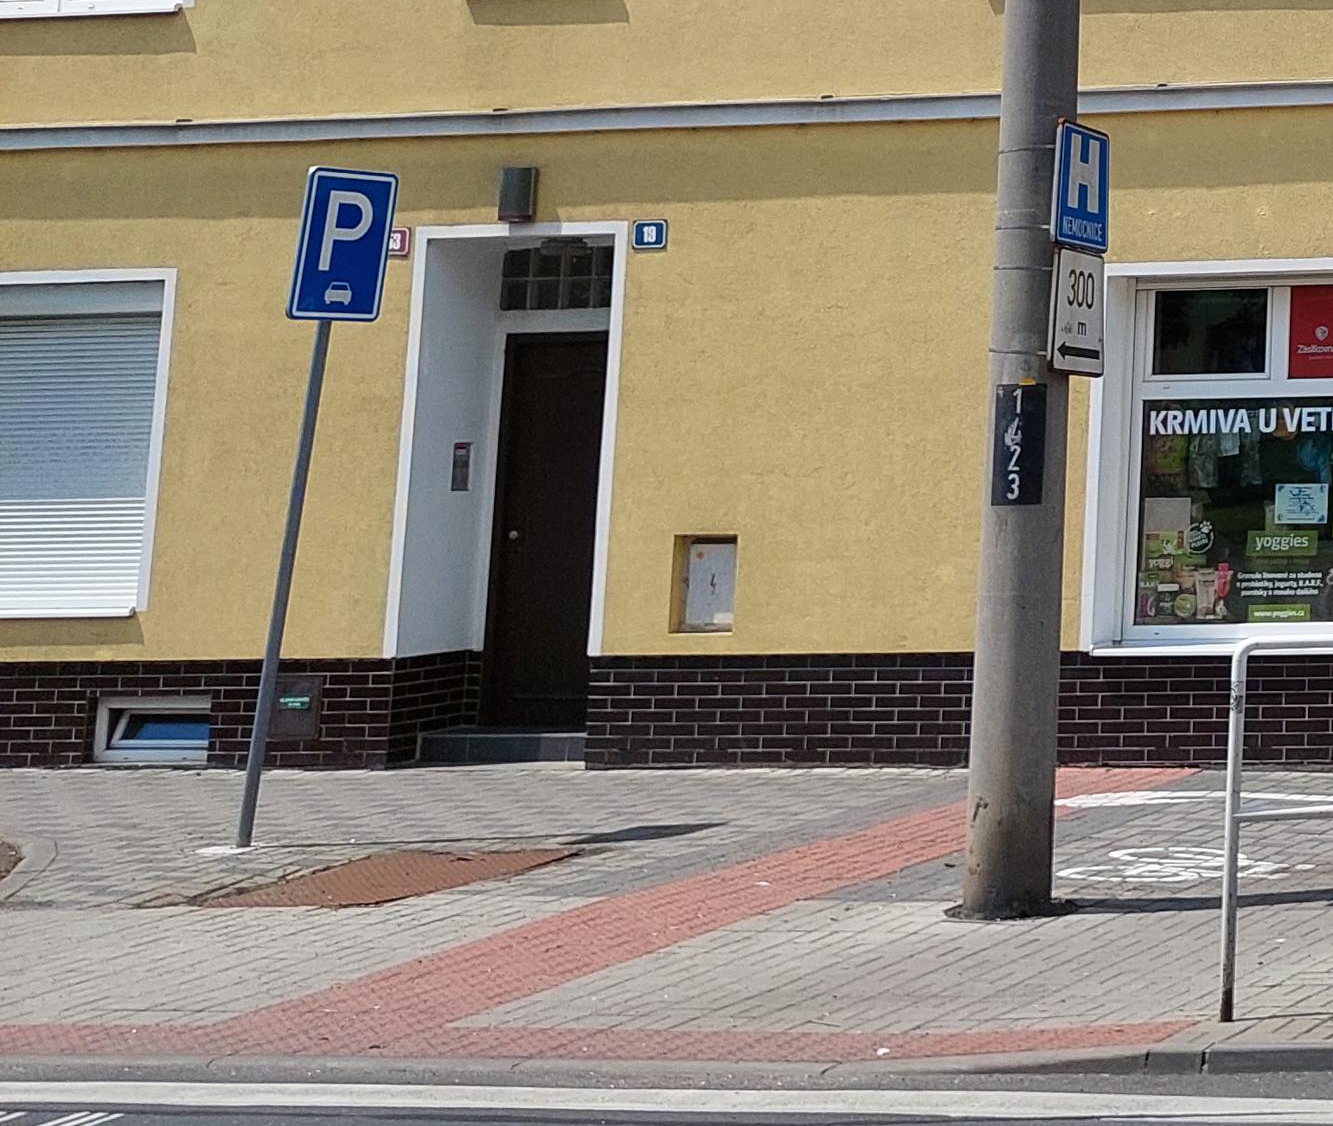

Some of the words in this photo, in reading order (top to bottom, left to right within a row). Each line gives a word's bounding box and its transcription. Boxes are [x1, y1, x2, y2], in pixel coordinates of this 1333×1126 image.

[1067, 133, 1100, 214] H
[318, 189, 374, 271] P
[643, 225, 657, 243] 19
[1062, 215, 1103, 242] NEMOCNICE
[1067, 268, 1095, 309] 300
[1077, 321, 1087, 336] m
[1149, 408, 1252, 436] KRMIVA
[1258, 407, 1277, 433] U
[1255, 533, 1309, 551] yoggies
